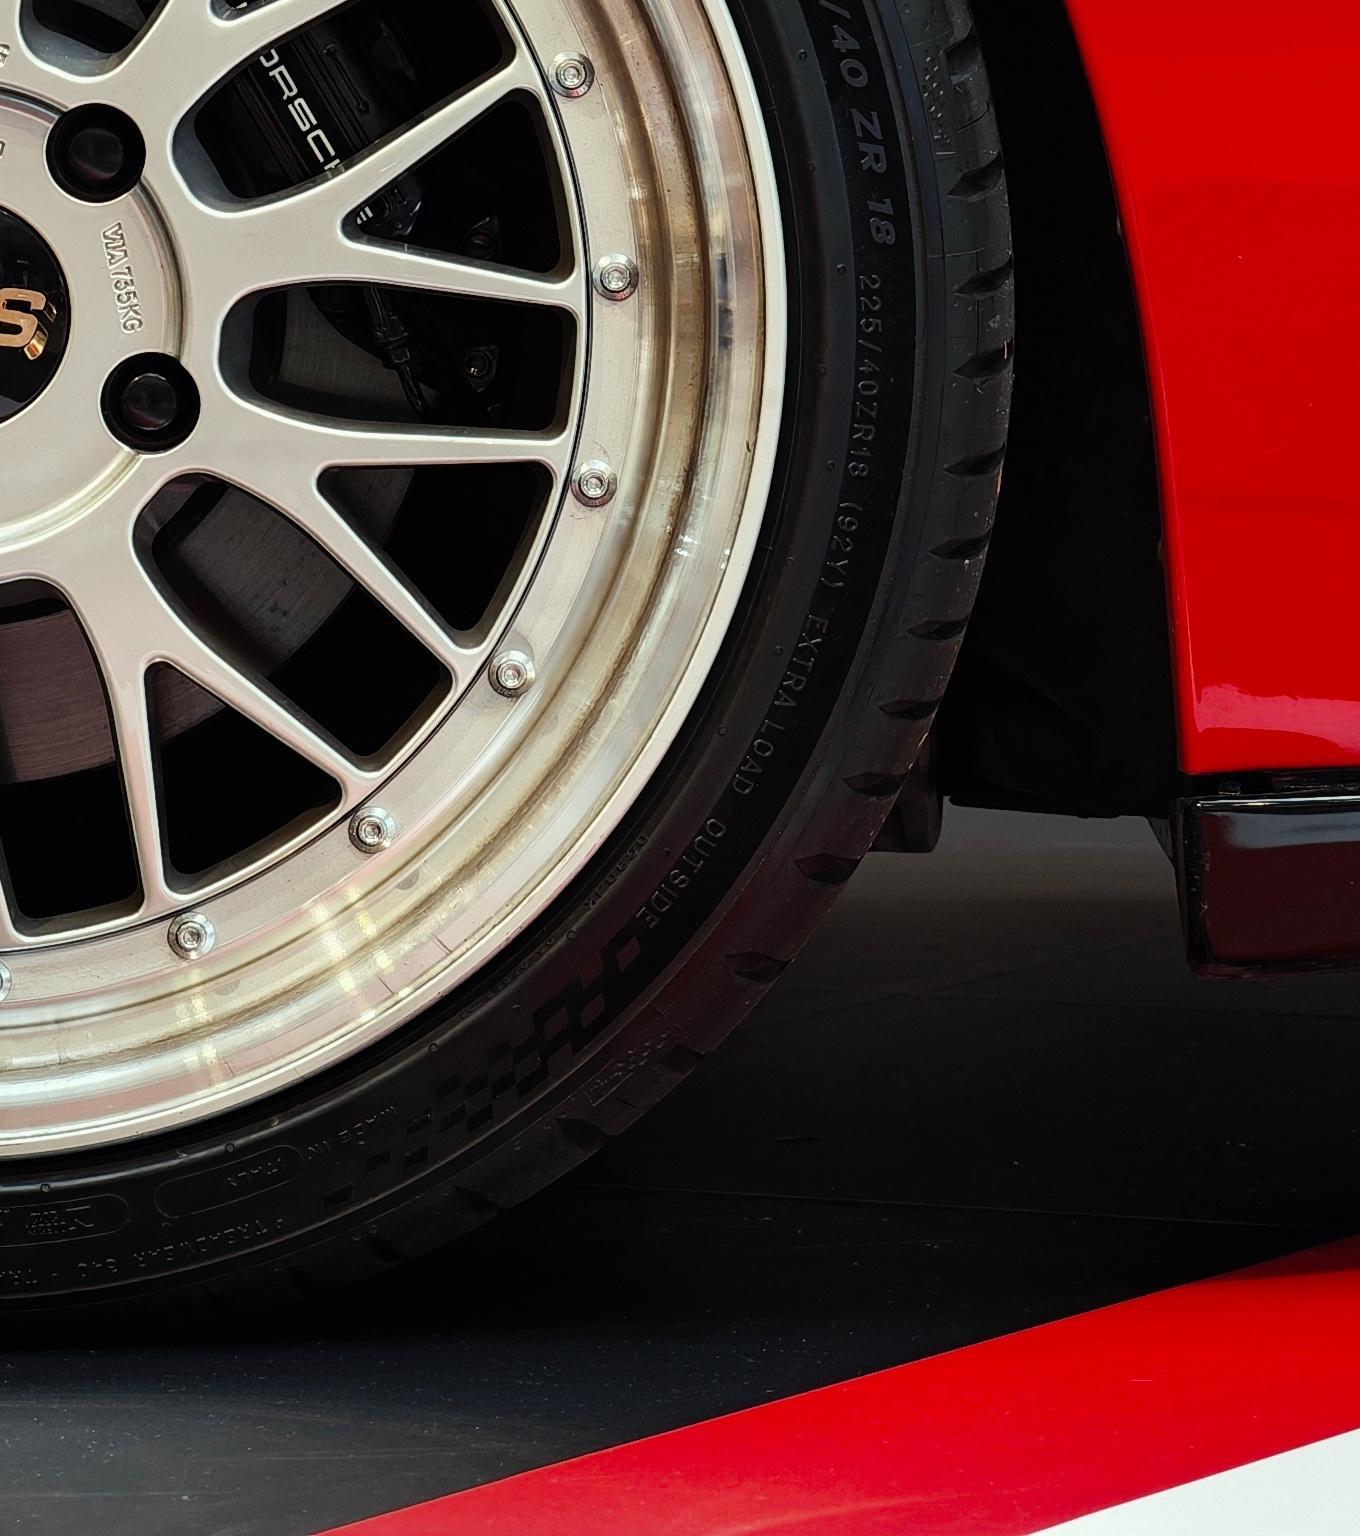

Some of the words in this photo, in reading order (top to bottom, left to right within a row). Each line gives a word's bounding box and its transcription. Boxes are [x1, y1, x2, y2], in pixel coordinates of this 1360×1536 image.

[849, 102, 888, 176] ZR
[865, 196, 897, 247] 18
[845, 272, 882, 479] 225/40ZR18
[818, 498, 864, 591] (92Y)
[772, 612, 829, 714] EXTRA
[728, 717, 785, 799] LOAD
[634, 814, 729, 931] OUTSIDE
[130, 1217, 270, 1271] TREADWEAR
